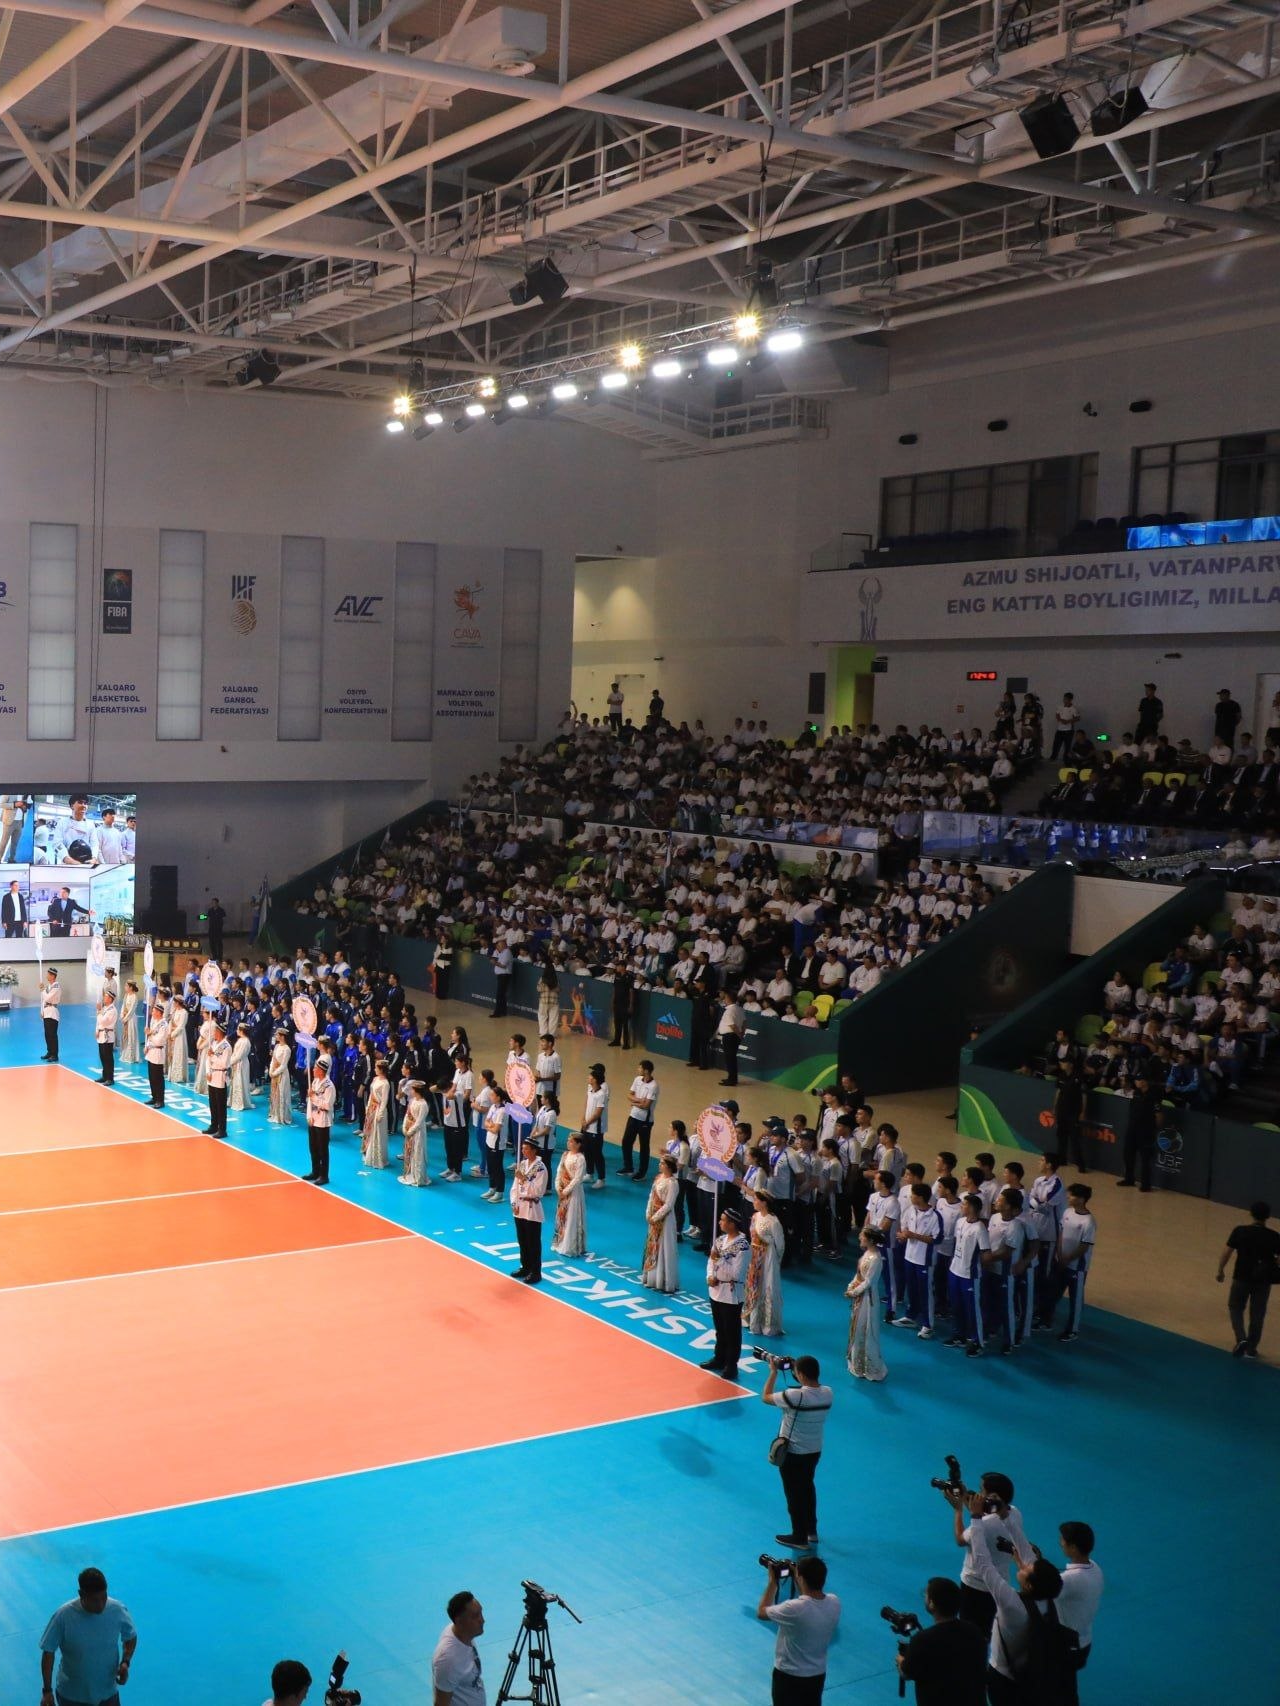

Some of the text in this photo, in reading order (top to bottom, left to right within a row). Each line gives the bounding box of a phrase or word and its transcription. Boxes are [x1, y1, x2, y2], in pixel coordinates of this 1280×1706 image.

[962, 570, 1018, 587] AZMU
[1024, 562, 1141, 585] SHIJOATLI,
[231, 575, 257, 600] IHF
[947, 586, 1280, 614] ENG KATTA BOYLIGIMIZ, MILLA
[107, 606, 128, 618] FIBA
[334, 596, 383, 617] AVC
[222, 685, 258, 693] XALQARO
[92, 695, 141, 703] BASKETBOL
[85, 706, 147, 714] FEDERATSIYASI
[210, 707, 269, 715] FEDERATSIYASI
